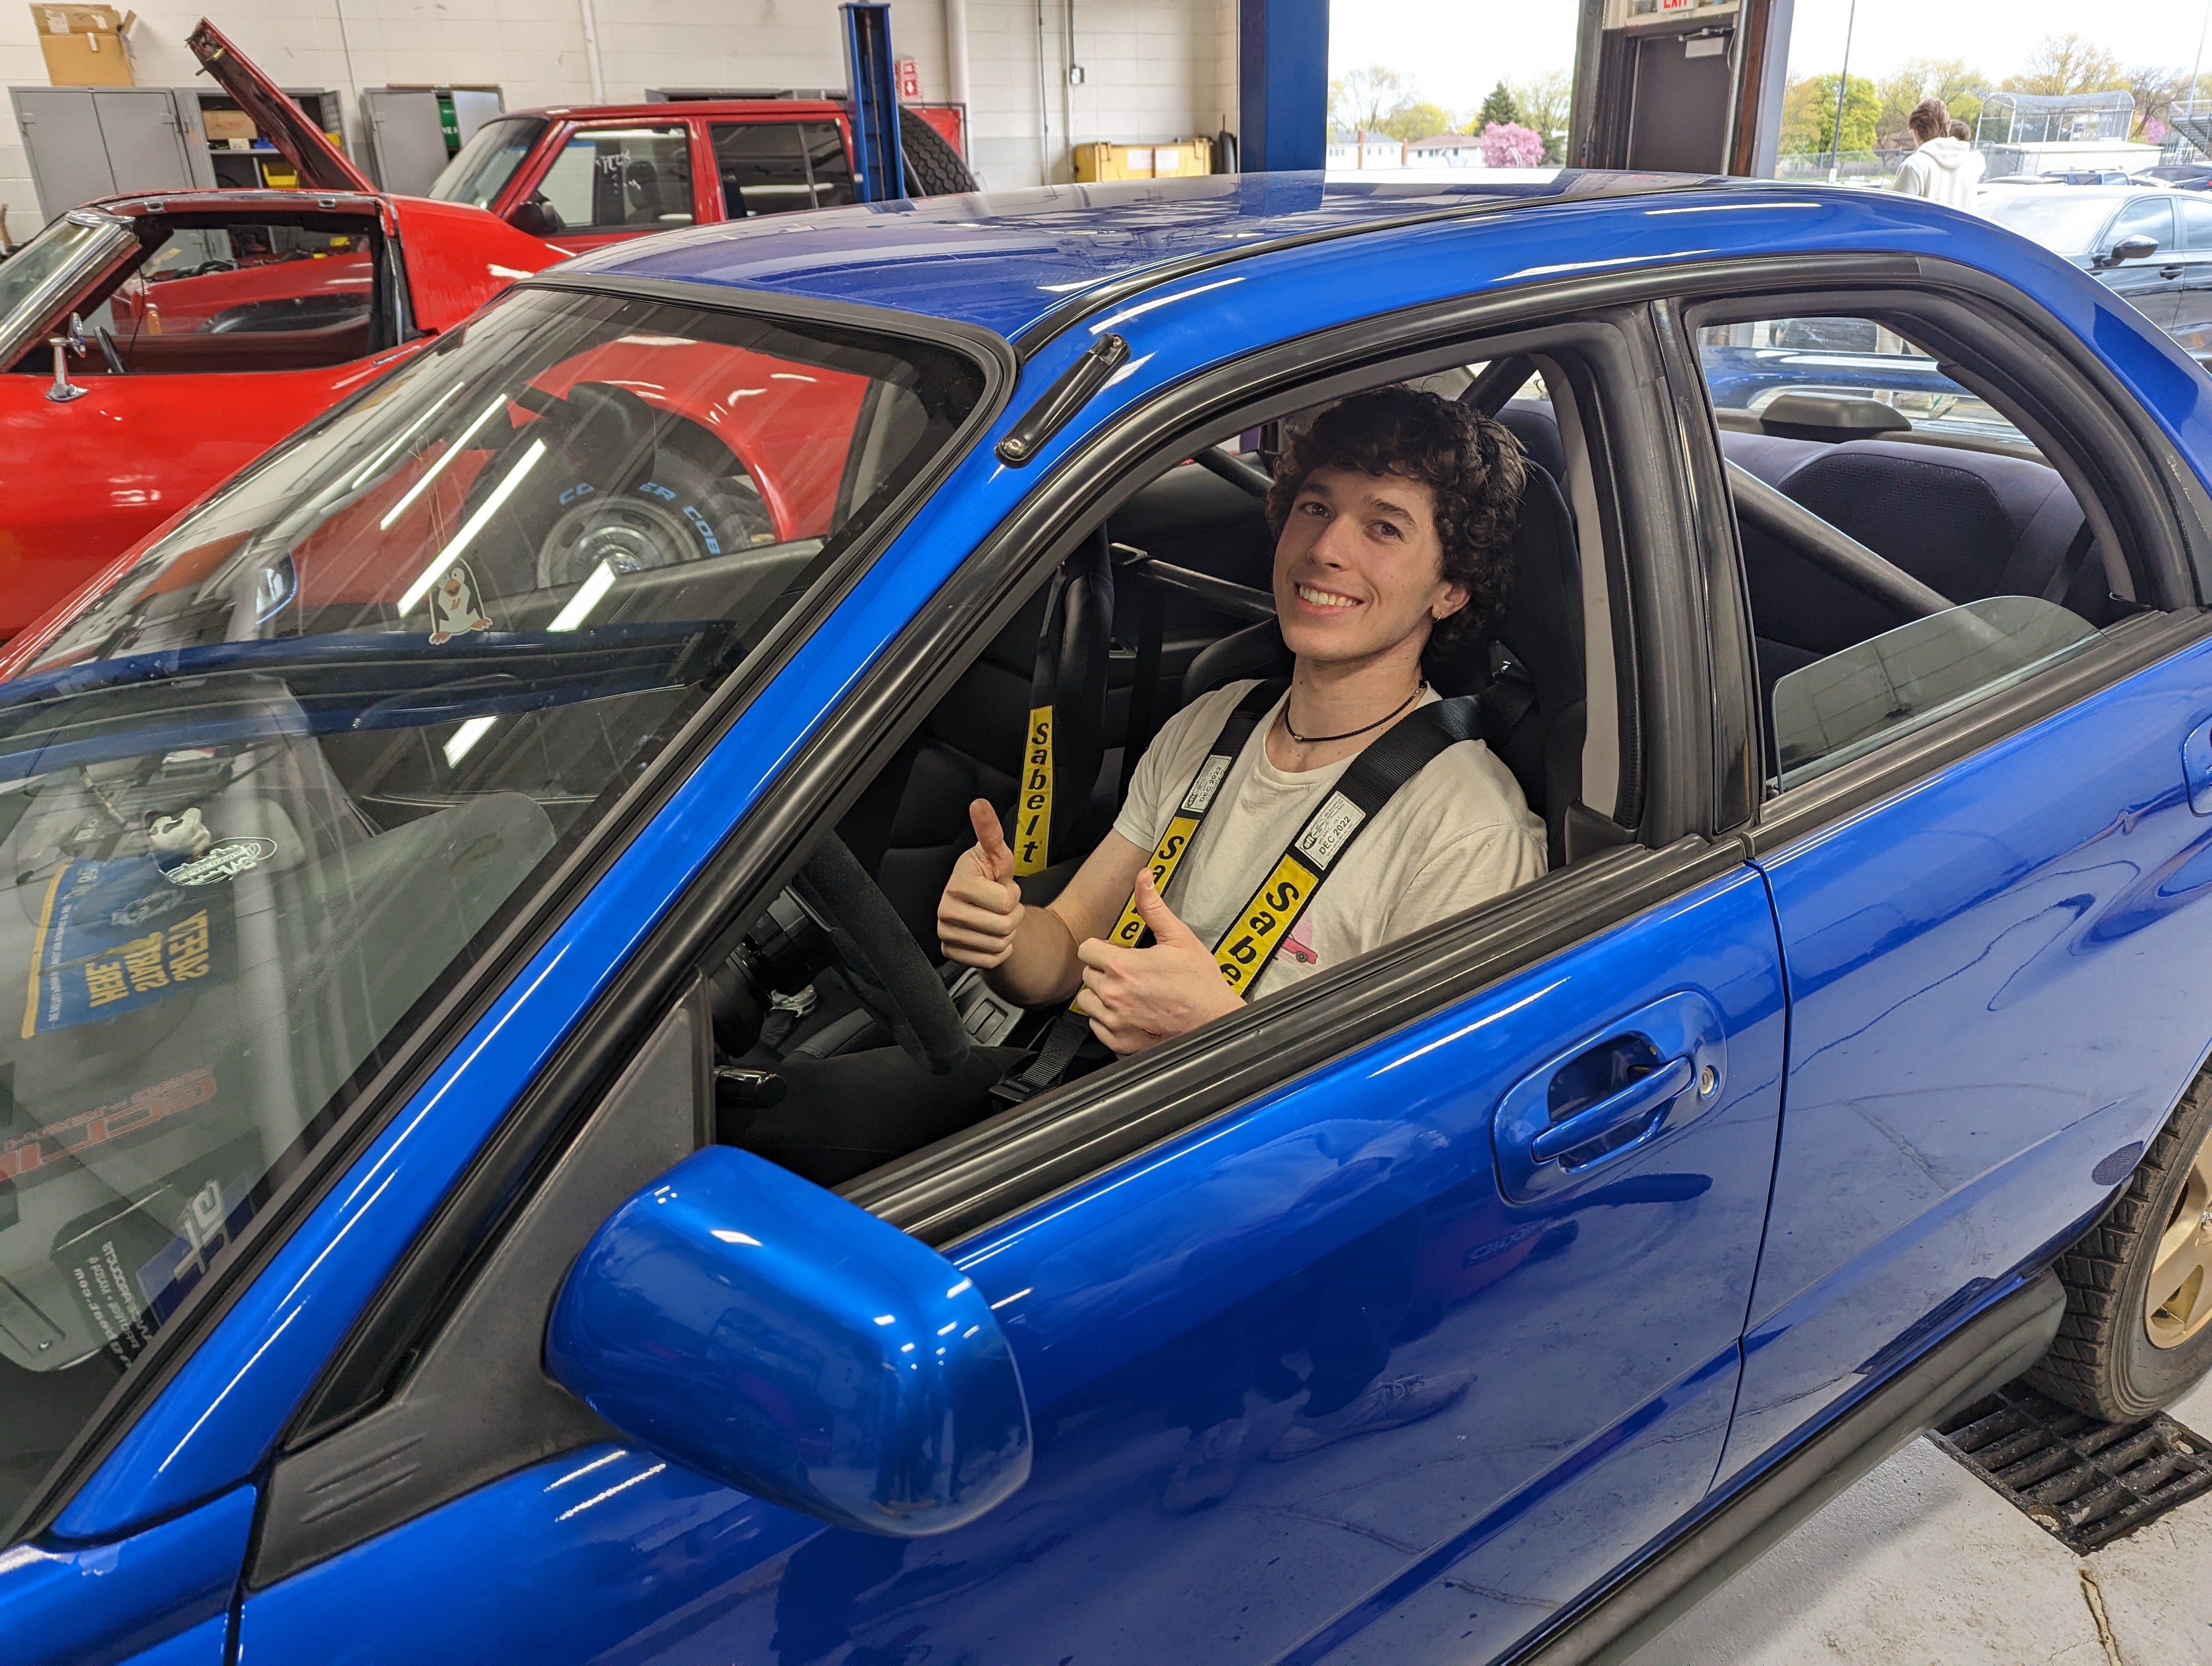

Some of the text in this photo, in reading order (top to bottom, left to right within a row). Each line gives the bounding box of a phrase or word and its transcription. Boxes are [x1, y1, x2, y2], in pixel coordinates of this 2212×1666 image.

[1023, 722, 1050, 863] Sabelt
[1200, 786, 1211, 803] DEC
[1210, 767, 1221, 784] 2022
[1319, 816, 1351, 855] DEC 2022
[1120, 835, 1185, 940] Sae
